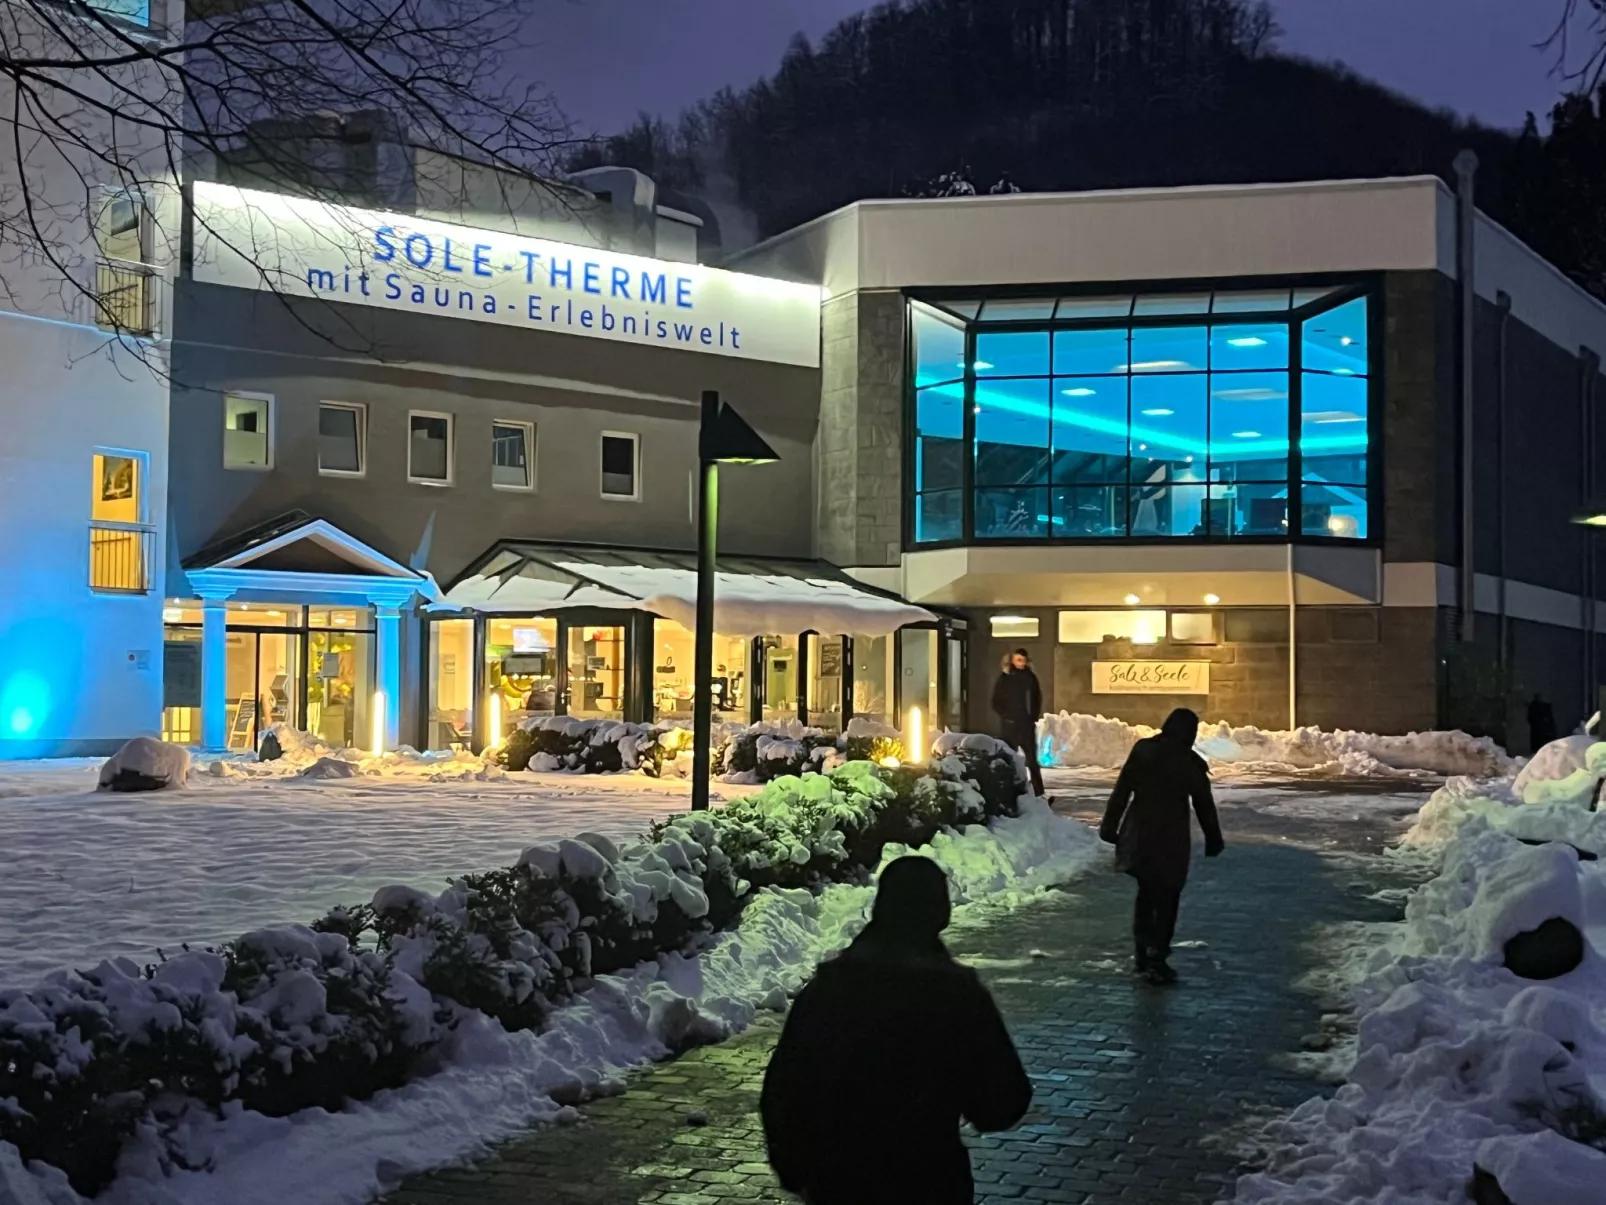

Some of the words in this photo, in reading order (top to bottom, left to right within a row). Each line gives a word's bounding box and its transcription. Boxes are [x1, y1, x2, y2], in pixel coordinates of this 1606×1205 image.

[307, 265, 371, 297] mit
[373, 226, 695, 309] SOLE-THERME
[1140, 666, 1153, 682] &
[1154, 664, 1189, 683] Seele
